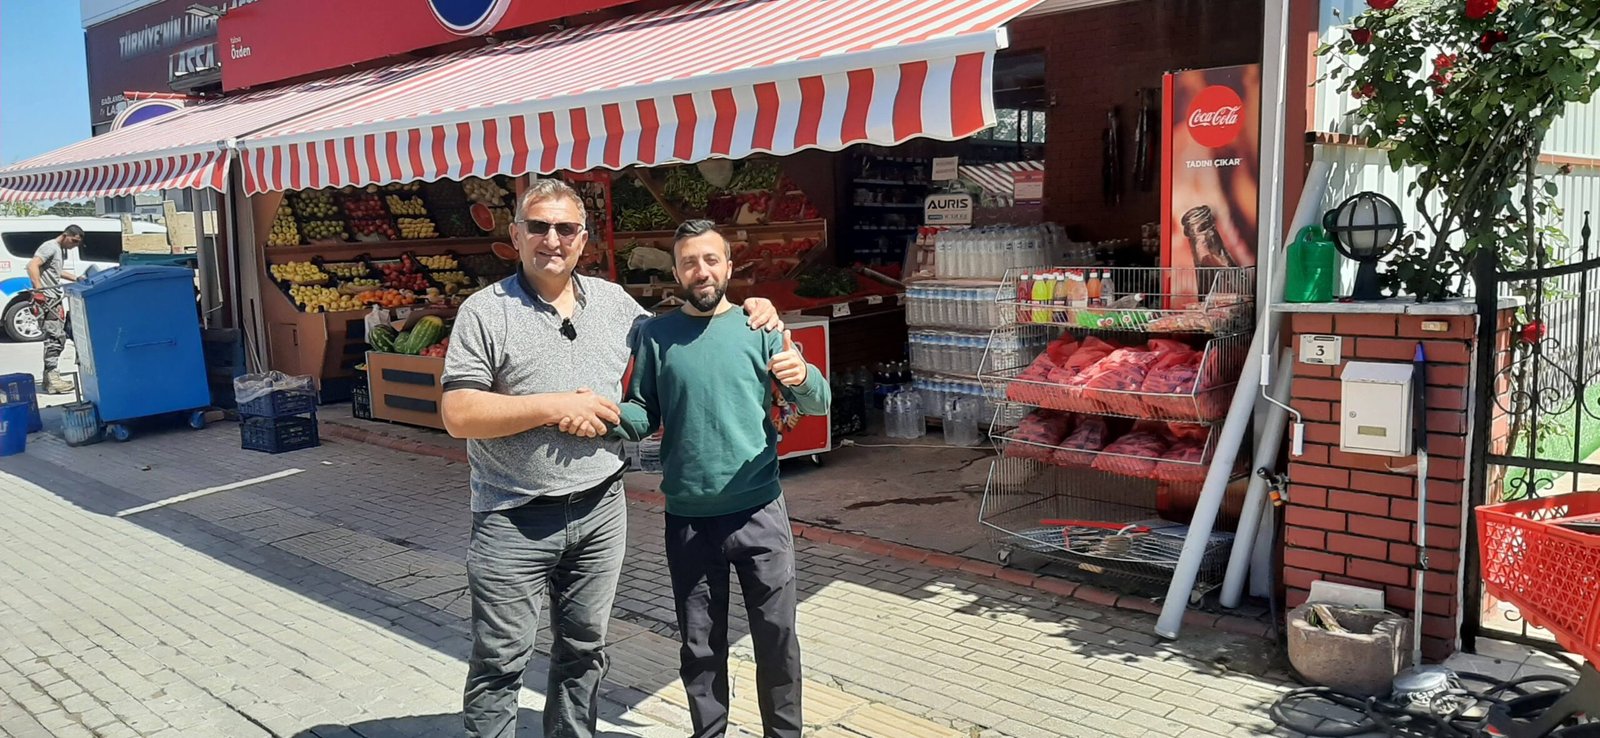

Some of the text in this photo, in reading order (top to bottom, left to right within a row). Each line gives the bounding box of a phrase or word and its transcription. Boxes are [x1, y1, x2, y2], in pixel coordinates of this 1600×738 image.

[231, 44, 251, 60] Özden
[1186, 158, 1240, 168] TADINI ÇIKAR
[927, 199, 969, 210] AURIS
[1315, 345, 1325, 356] 3
